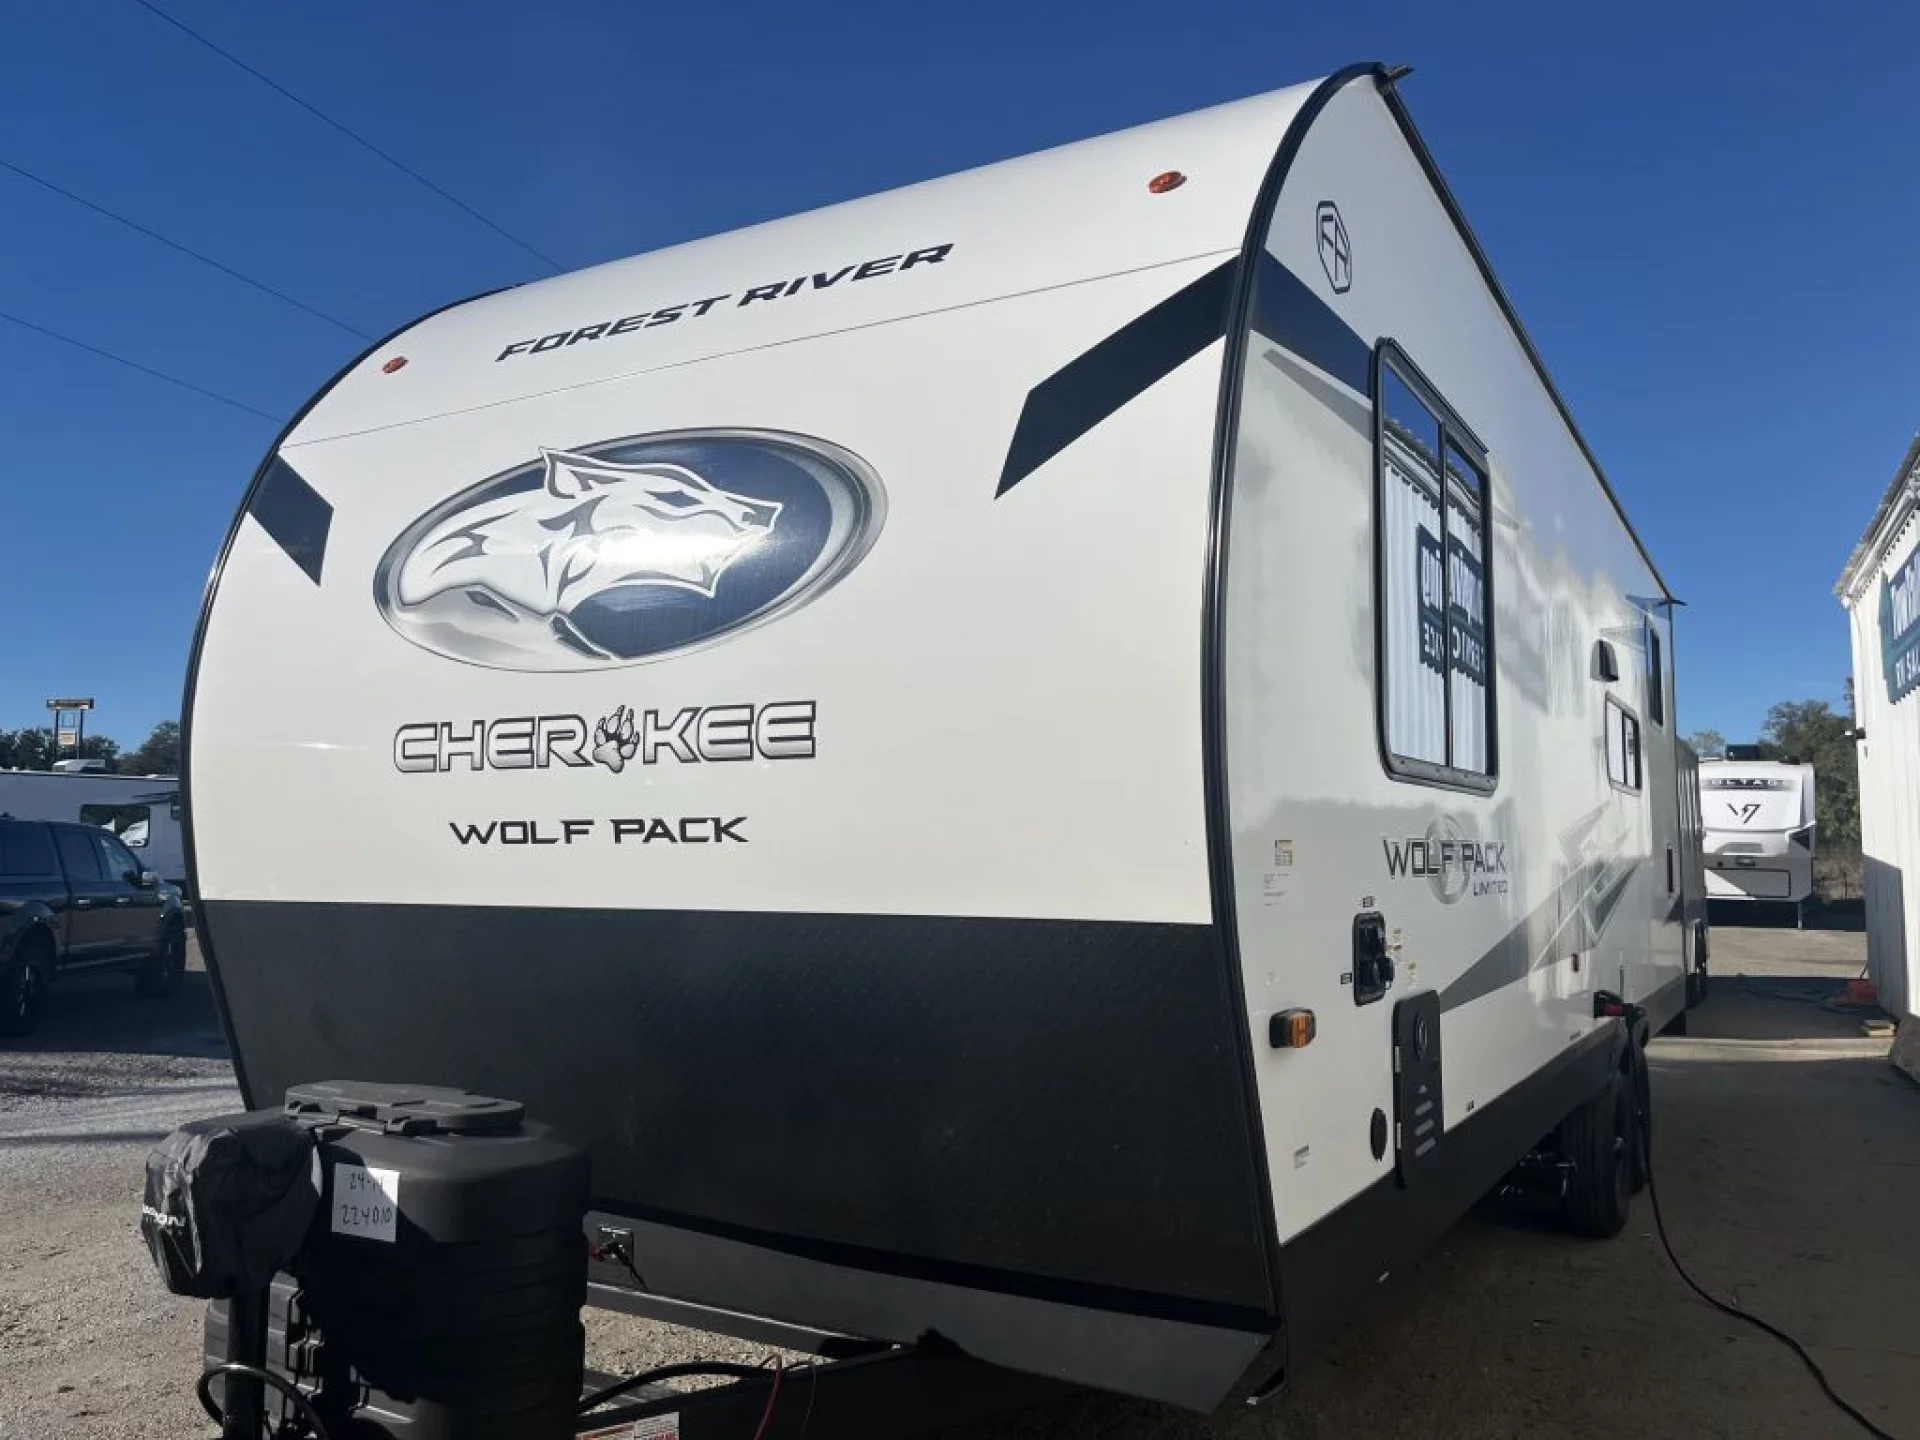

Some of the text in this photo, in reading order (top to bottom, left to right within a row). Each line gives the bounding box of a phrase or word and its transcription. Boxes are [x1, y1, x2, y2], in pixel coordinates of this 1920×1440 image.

[494, 243, 955, 363] FOREST RIVER
[448, 816, 749, 845] WOLF PACK
[1382, 837, 1507, 879] WOLF PACK
[1472, 879, 1508, 897] LIMITED
